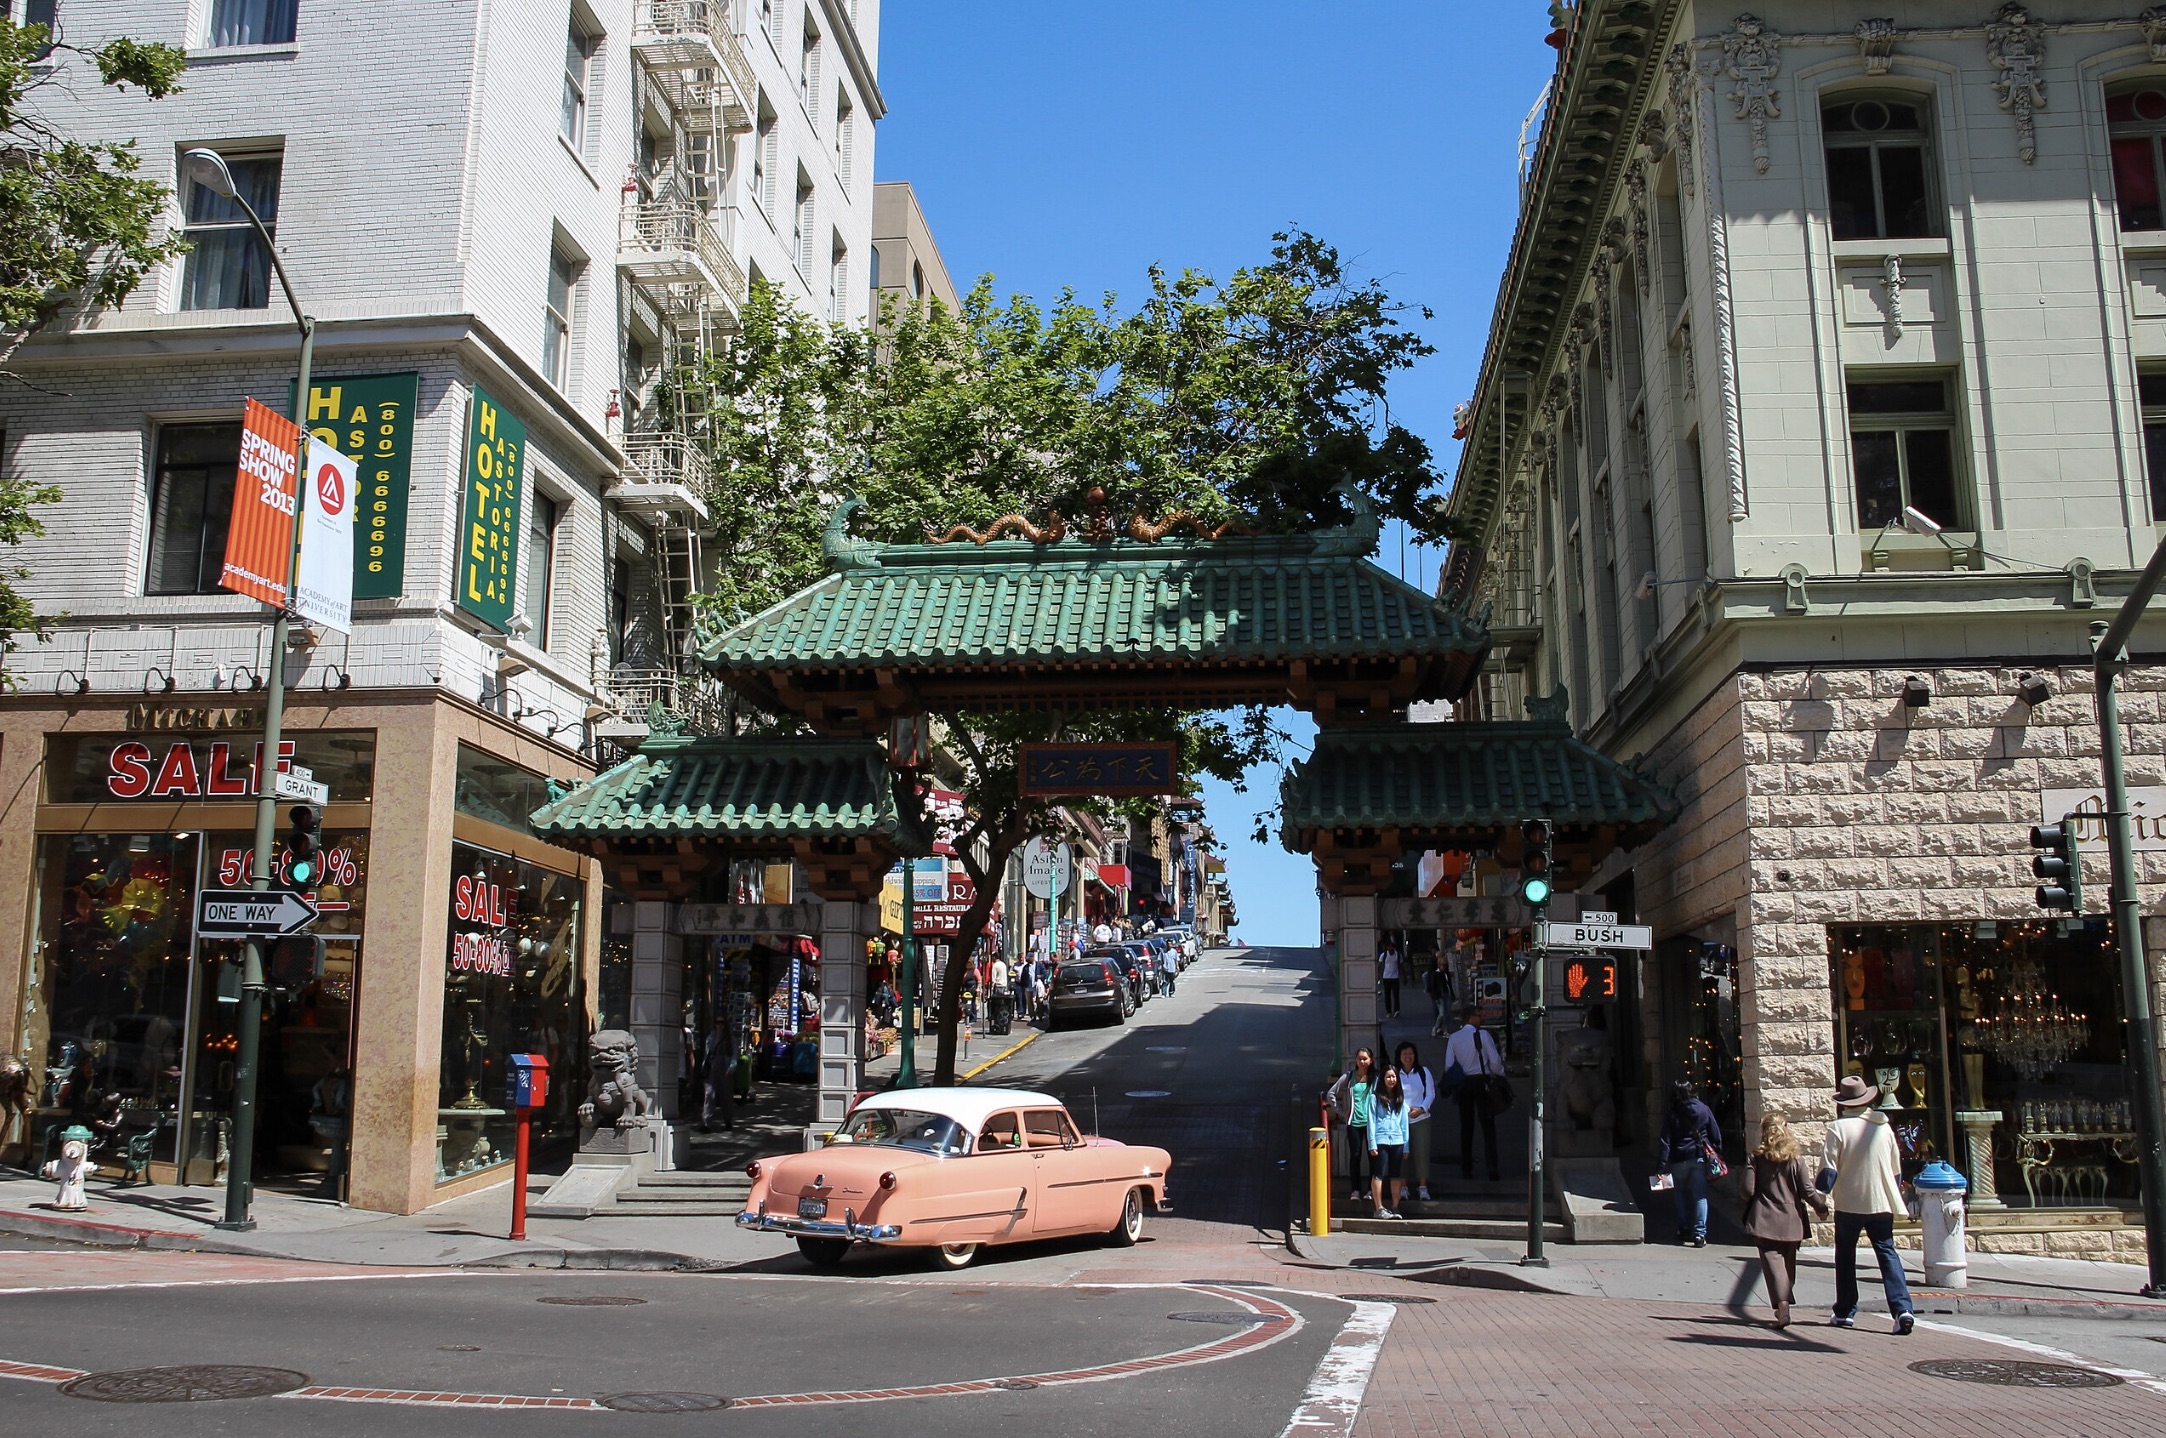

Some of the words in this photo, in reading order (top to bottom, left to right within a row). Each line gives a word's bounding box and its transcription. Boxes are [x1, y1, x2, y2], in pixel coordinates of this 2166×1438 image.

[374, 402, 400, 458] (800)
[241, 428, 296, 476] SPRING
[239, 449, 285, 489] SHOW
[504, 442, 518, 500] (800)
[260, 483, 296, 516] 2013
[468, 400, 496, 603] HOTEL
[368, 470, 390, 573] 6666696
[486, 437, 505, 600] ASTORIA
[498, 506, 512, 604] 6666696
[224, 562, 286, 594] academyart.edu
[298, 597, 348, 623] UNIVERSITY
[299, 586, 331, 605] ACADEMY
[335, 602, 348, 613] ART
[285, 779, 319, 798] GRANT
[1029, 865, 1064, 876] Imae
[1031, 854, 1063, 864] Asin
[208, 904, 238, 920] ONE
[245, 905, 276, 921] WAY
[455, 875, 518, 930] SALE
[934, 904, 973, 913] RESTAURA
[1595, 913, 1614, 923] 500
[1575, 928, 1624, 943] BUSH
[453, 933, 502, 975] 50-80%
[1603, 965, 1615, 996] 3
